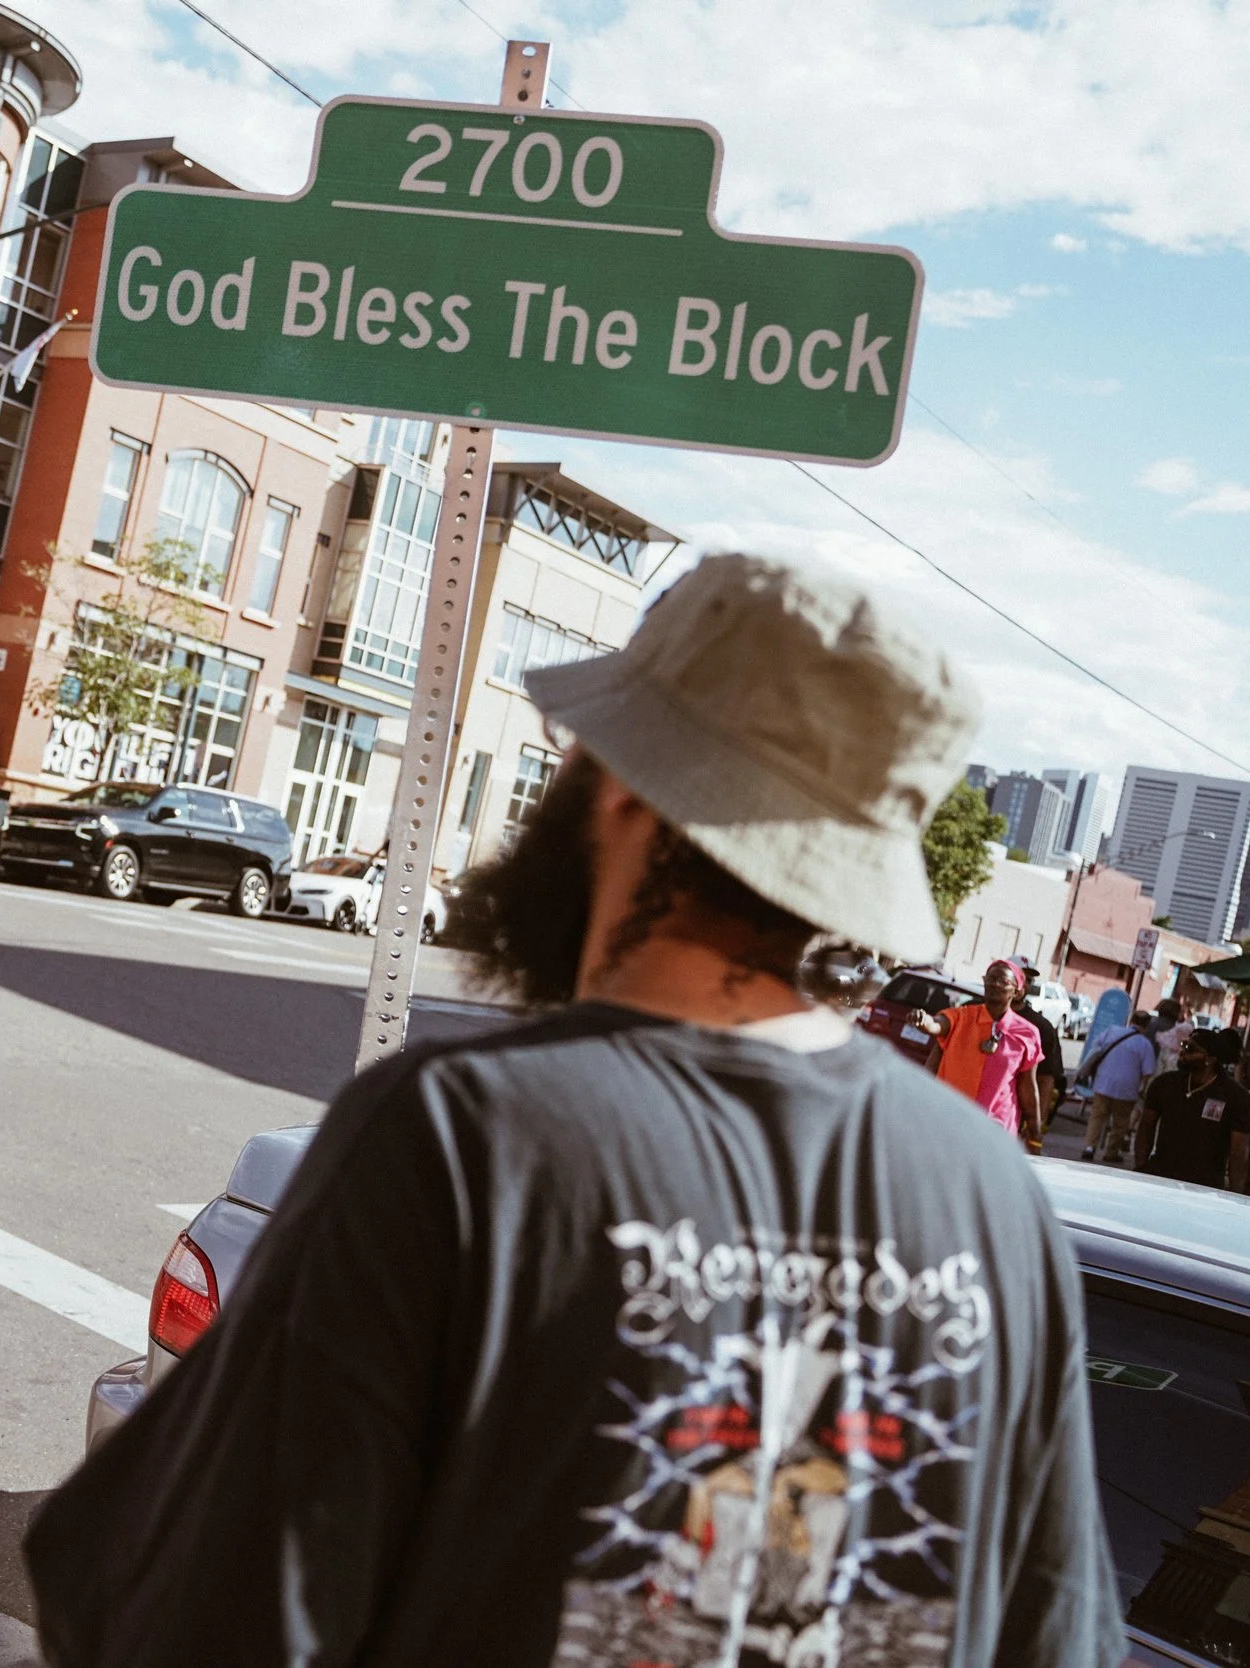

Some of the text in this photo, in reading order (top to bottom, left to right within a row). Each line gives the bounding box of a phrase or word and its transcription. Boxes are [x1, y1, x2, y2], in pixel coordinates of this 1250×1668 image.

[398, 123, 624, 208] 2700
[117, 245, 892, 396] God Bless The Block
